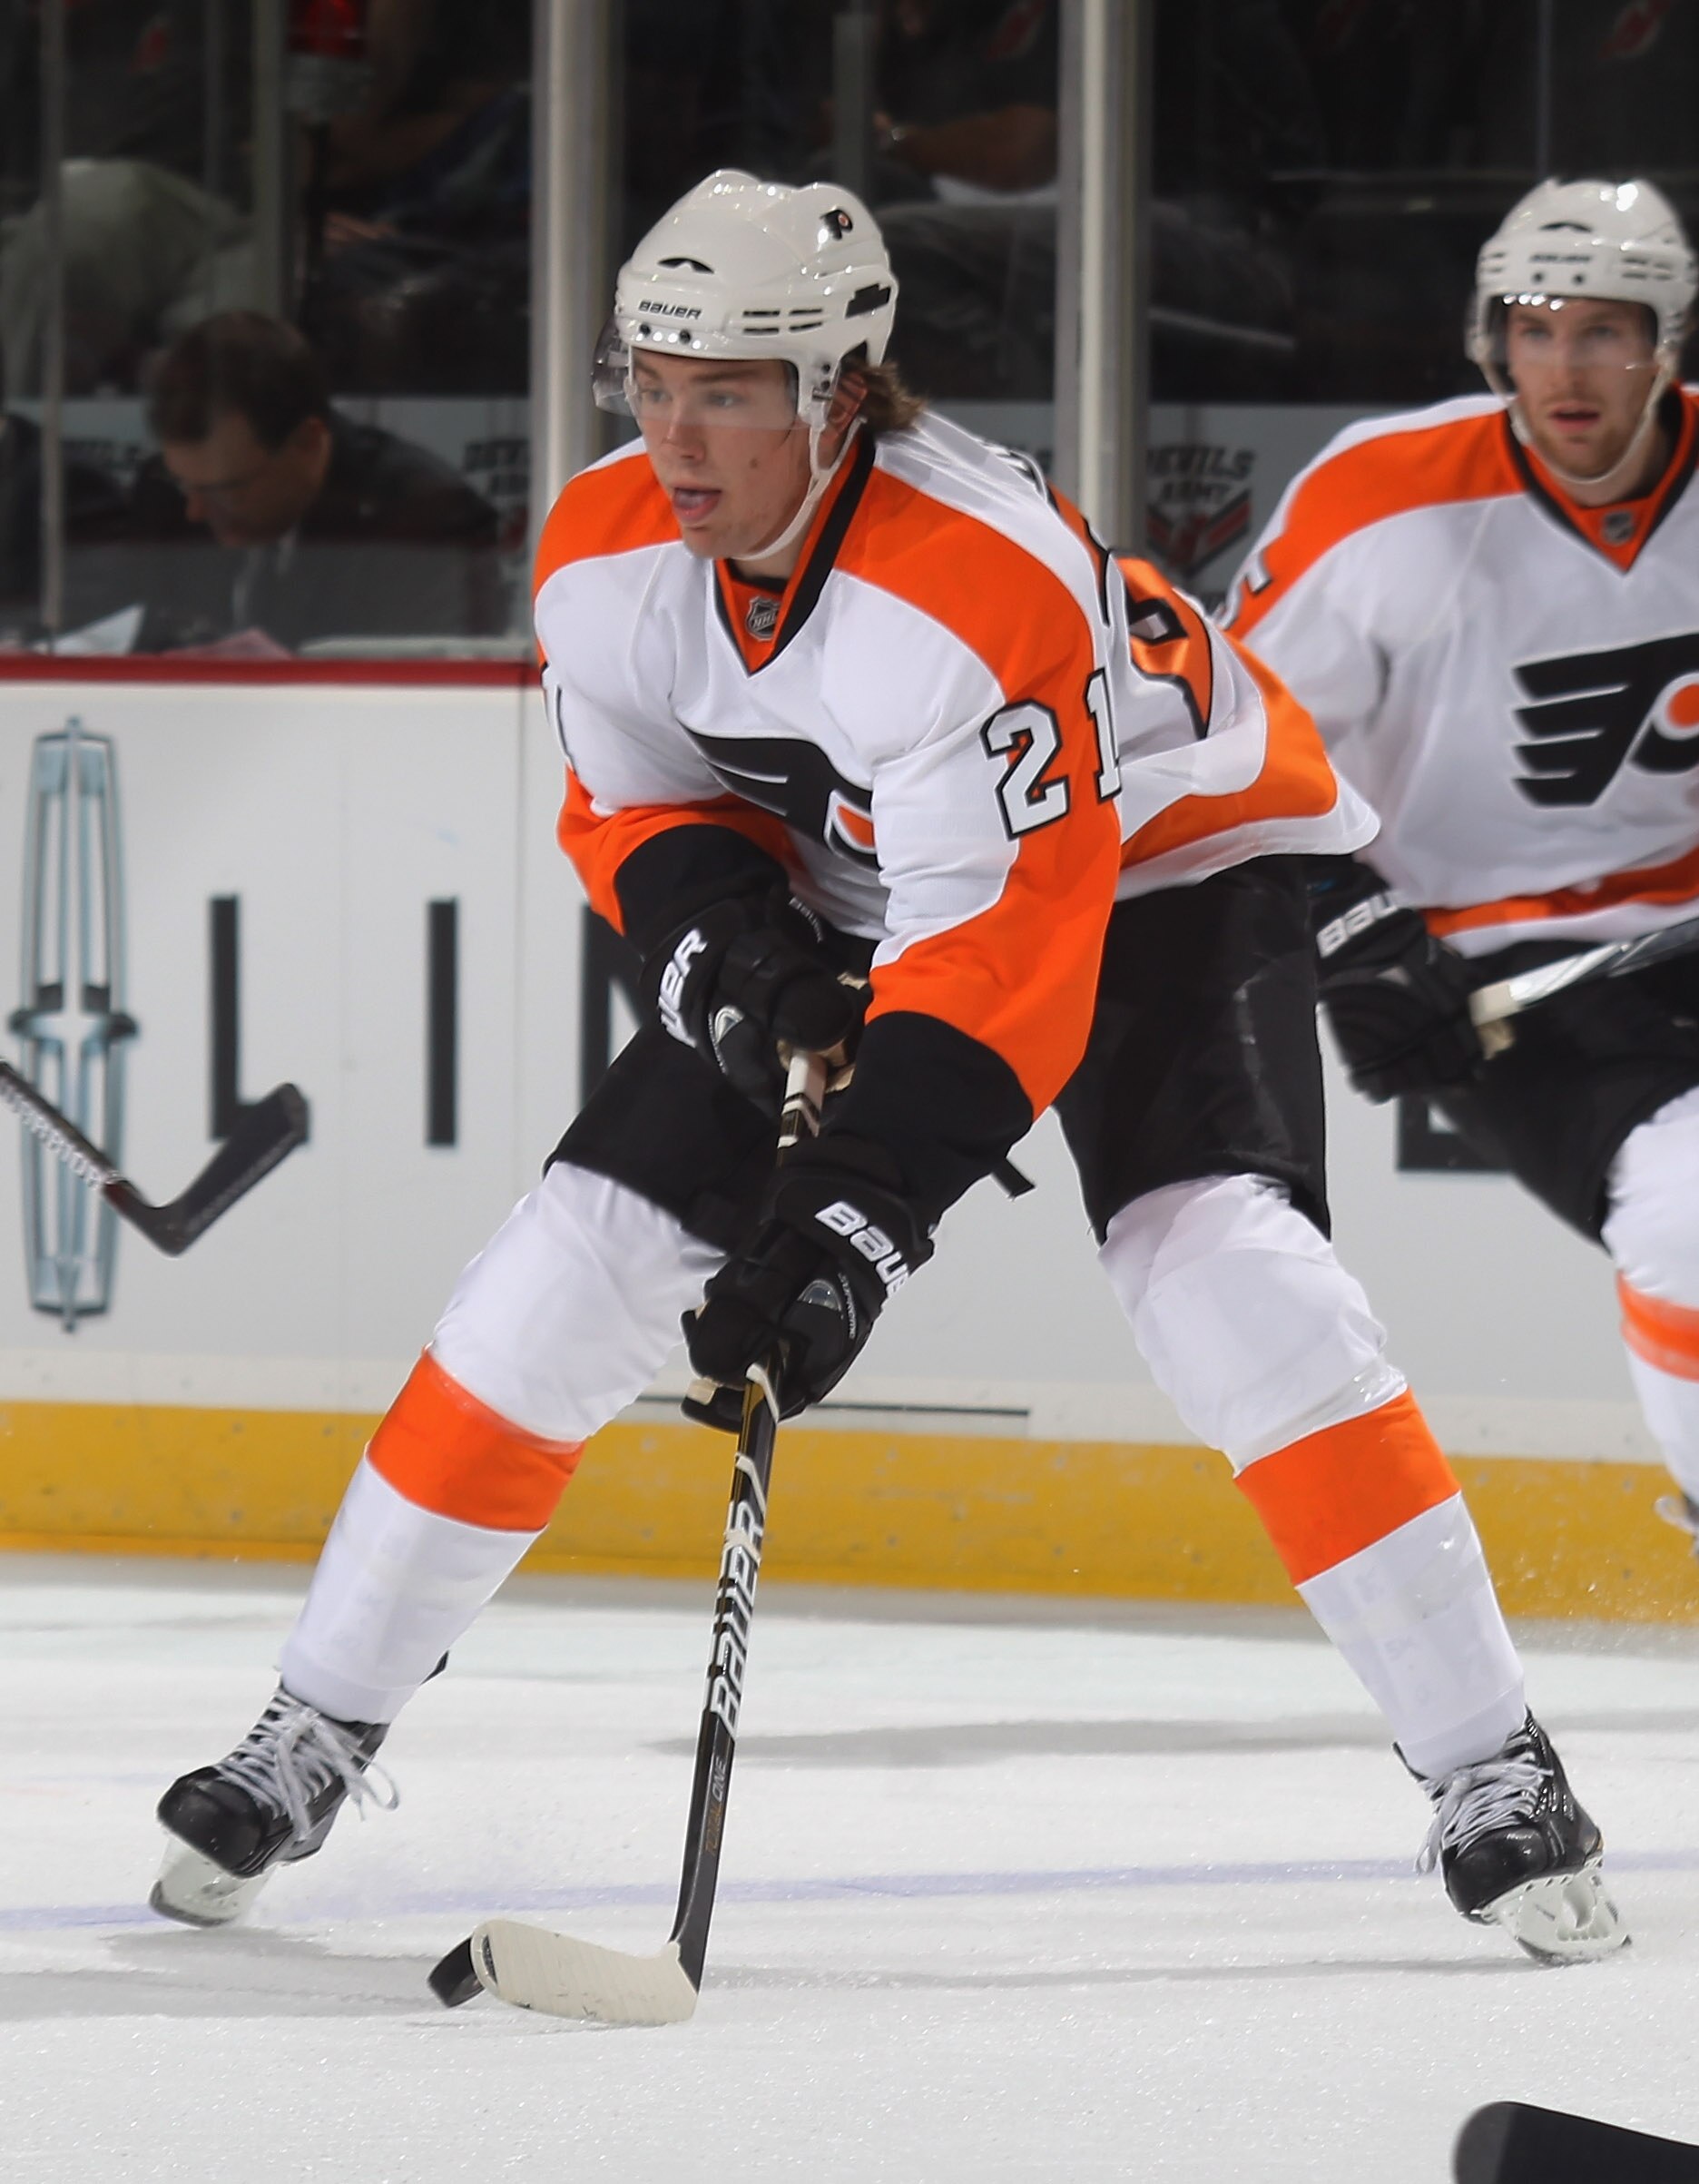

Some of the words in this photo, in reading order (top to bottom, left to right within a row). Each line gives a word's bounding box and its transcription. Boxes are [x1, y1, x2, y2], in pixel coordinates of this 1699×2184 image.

[638, 300, 702, 320] BAUER
[979, 667, 1123, 841] 21
[712, 1756, 727, 1802] ONE
